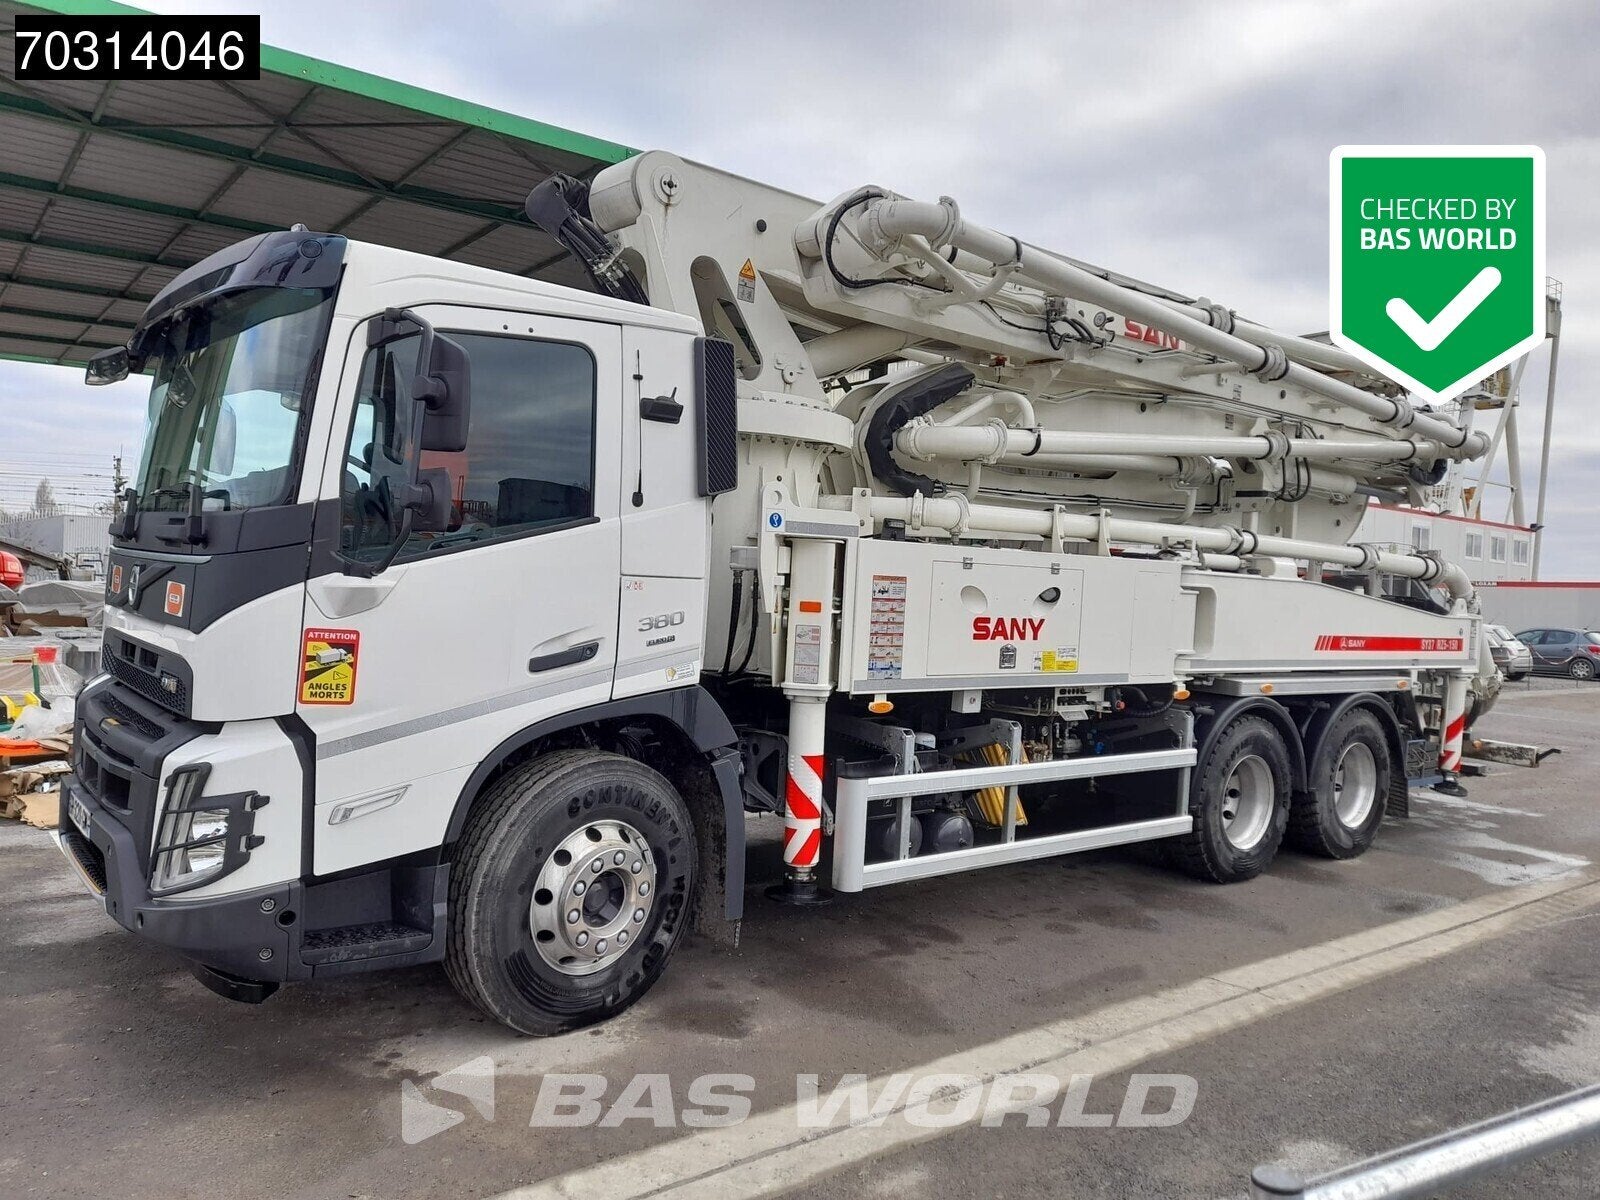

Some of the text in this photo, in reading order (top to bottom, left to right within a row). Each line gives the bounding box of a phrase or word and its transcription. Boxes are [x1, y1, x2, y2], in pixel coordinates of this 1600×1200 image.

[1124, 317, 1180, 350] SAN
[638, 610, 685, 632] 380
[972, 616, 1046, 641] SANY
[308, 631, 357, 640] ATTENTION
[1348, 639, 1366, 648] SANY
[308, 682, 347, 691] ANGLES
[309, 691, 345, 699] MORTS
